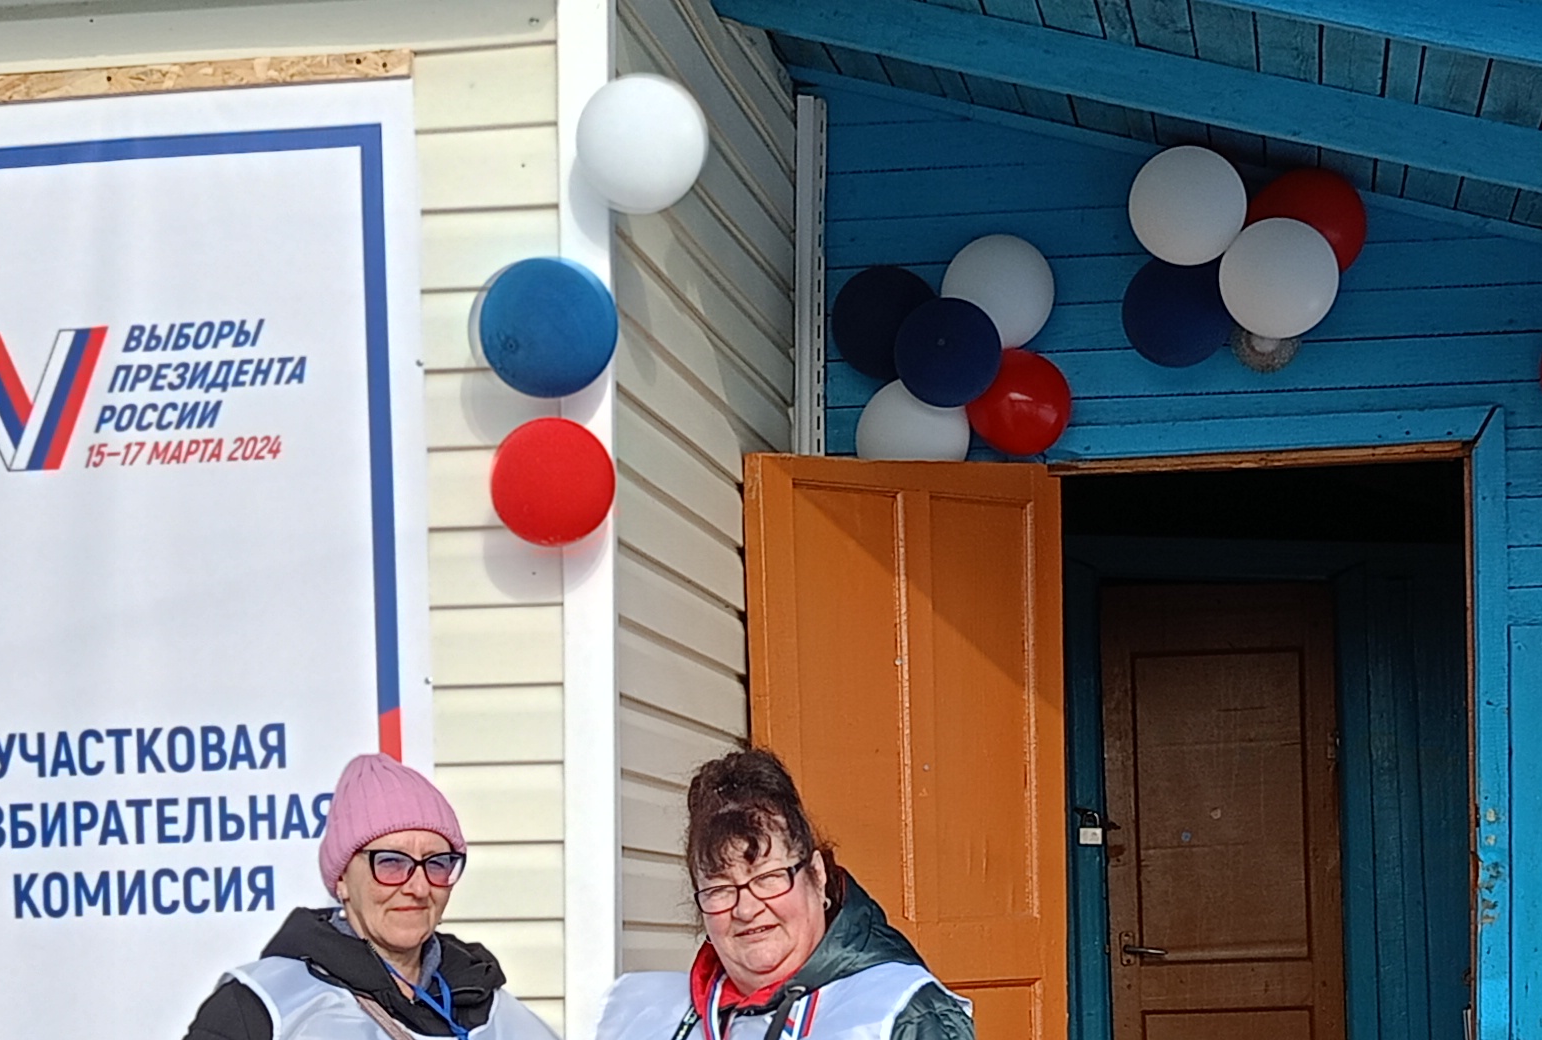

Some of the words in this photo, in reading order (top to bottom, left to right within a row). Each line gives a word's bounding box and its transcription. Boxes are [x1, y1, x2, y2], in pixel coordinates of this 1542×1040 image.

[121, 318, 265, 353] ВЫБОРЫ
[108, 356, 307, 393] ПРЕЗИДЕНТА
[94, 400, 223, 433] РОССИИ
[147, 438, 224, 465] МАРТА
[227, 435, 282, 461] 2024
[13, 865, 275, 919] КОМИССИЯ
